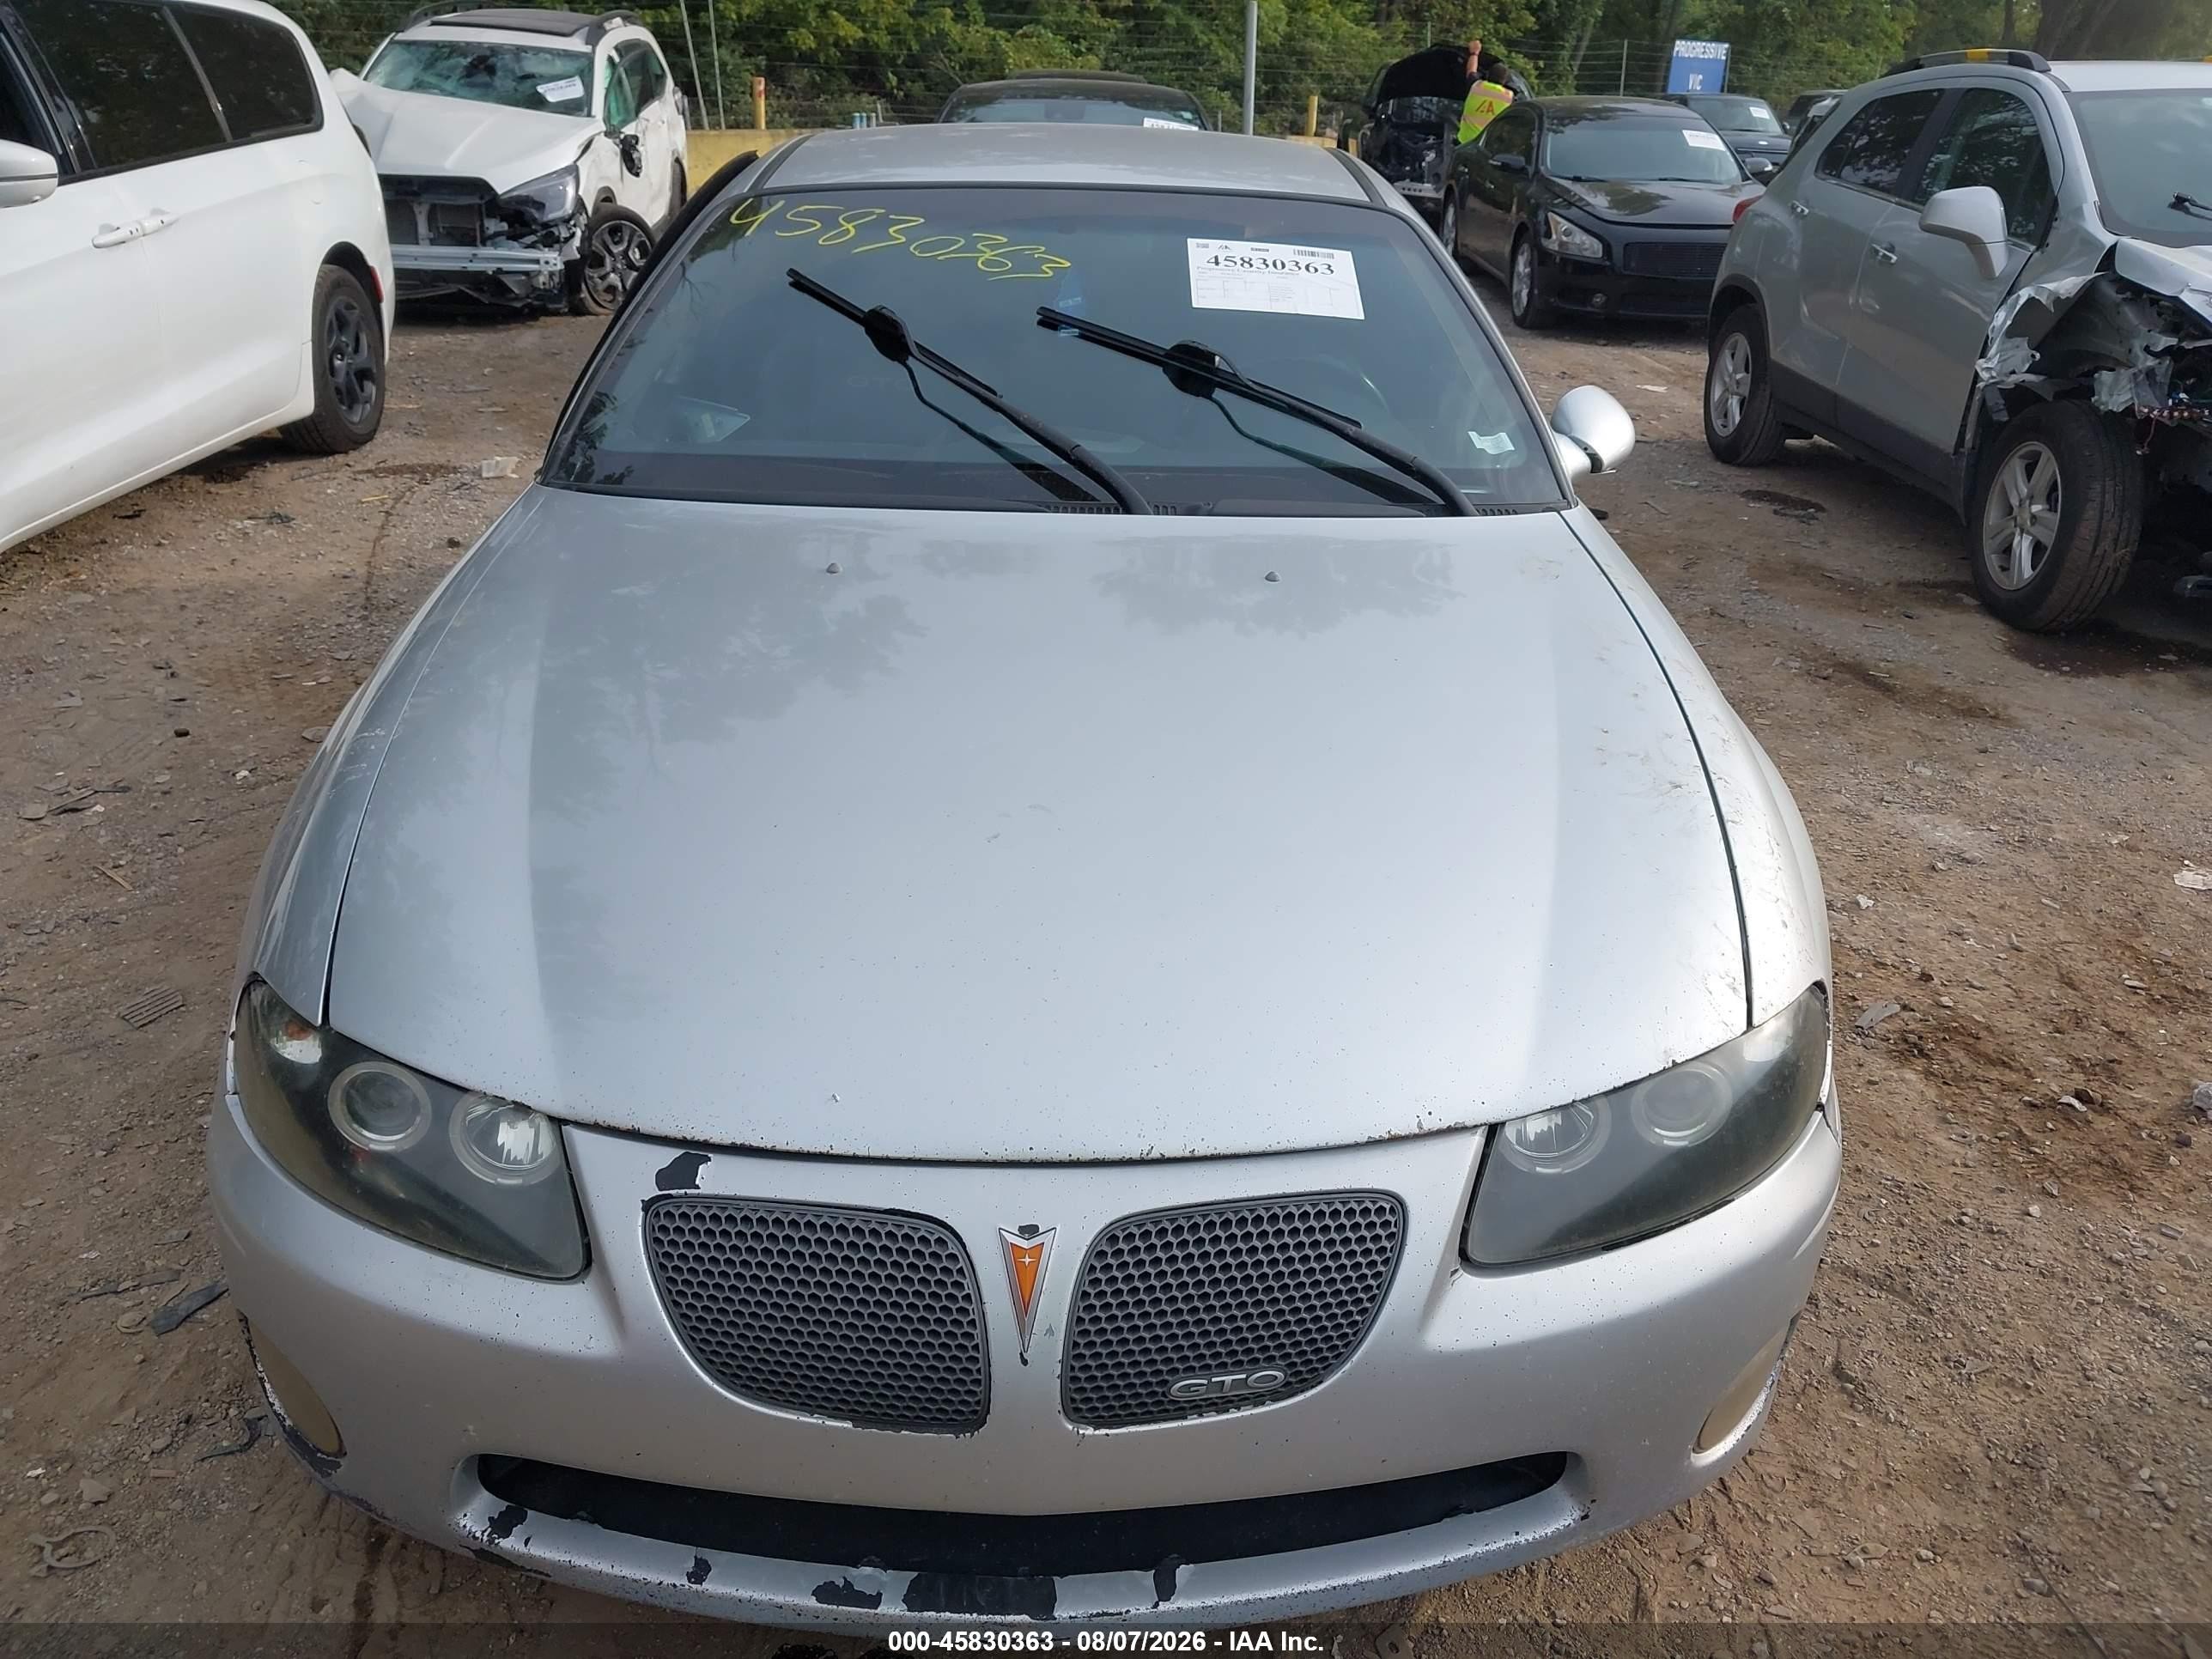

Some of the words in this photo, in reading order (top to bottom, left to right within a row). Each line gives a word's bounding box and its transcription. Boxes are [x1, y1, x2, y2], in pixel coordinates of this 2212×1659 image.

[1673, 40, 1729, 60] PROGRESSIVE
[730, 198, 1071, 281] 45830363
[1206, 255, 1334, 276] 45830363
[1170, 1370, 1285, 1398] GTO
